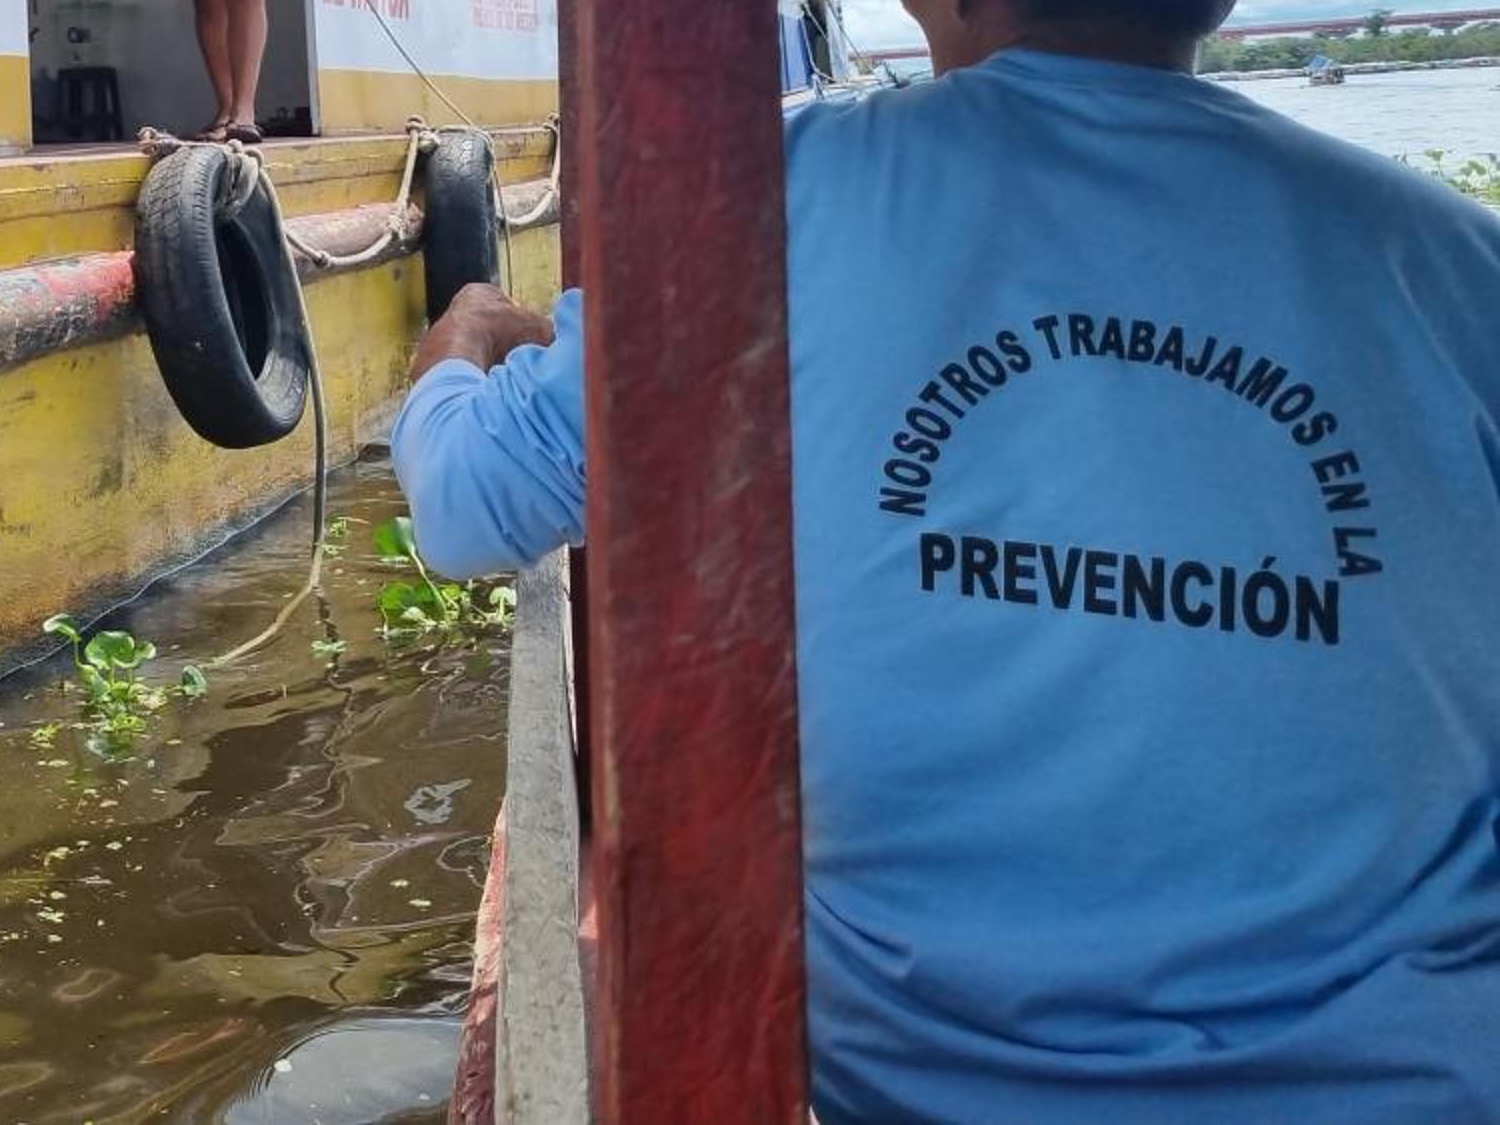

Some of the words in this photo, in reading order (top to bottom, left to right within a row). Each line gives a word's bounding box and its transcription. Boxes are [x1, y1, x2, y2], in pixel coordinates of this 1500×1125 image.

[878, 329, 1034, 518] NOSOTROS
[1032, 313, 1339, 447] TRABAJAMOS
[1310, 449, 1371, 512] EN
[919, 531, 1340, 646] PREVENCIÓN
[1331, 525, 1384, 576] LA
